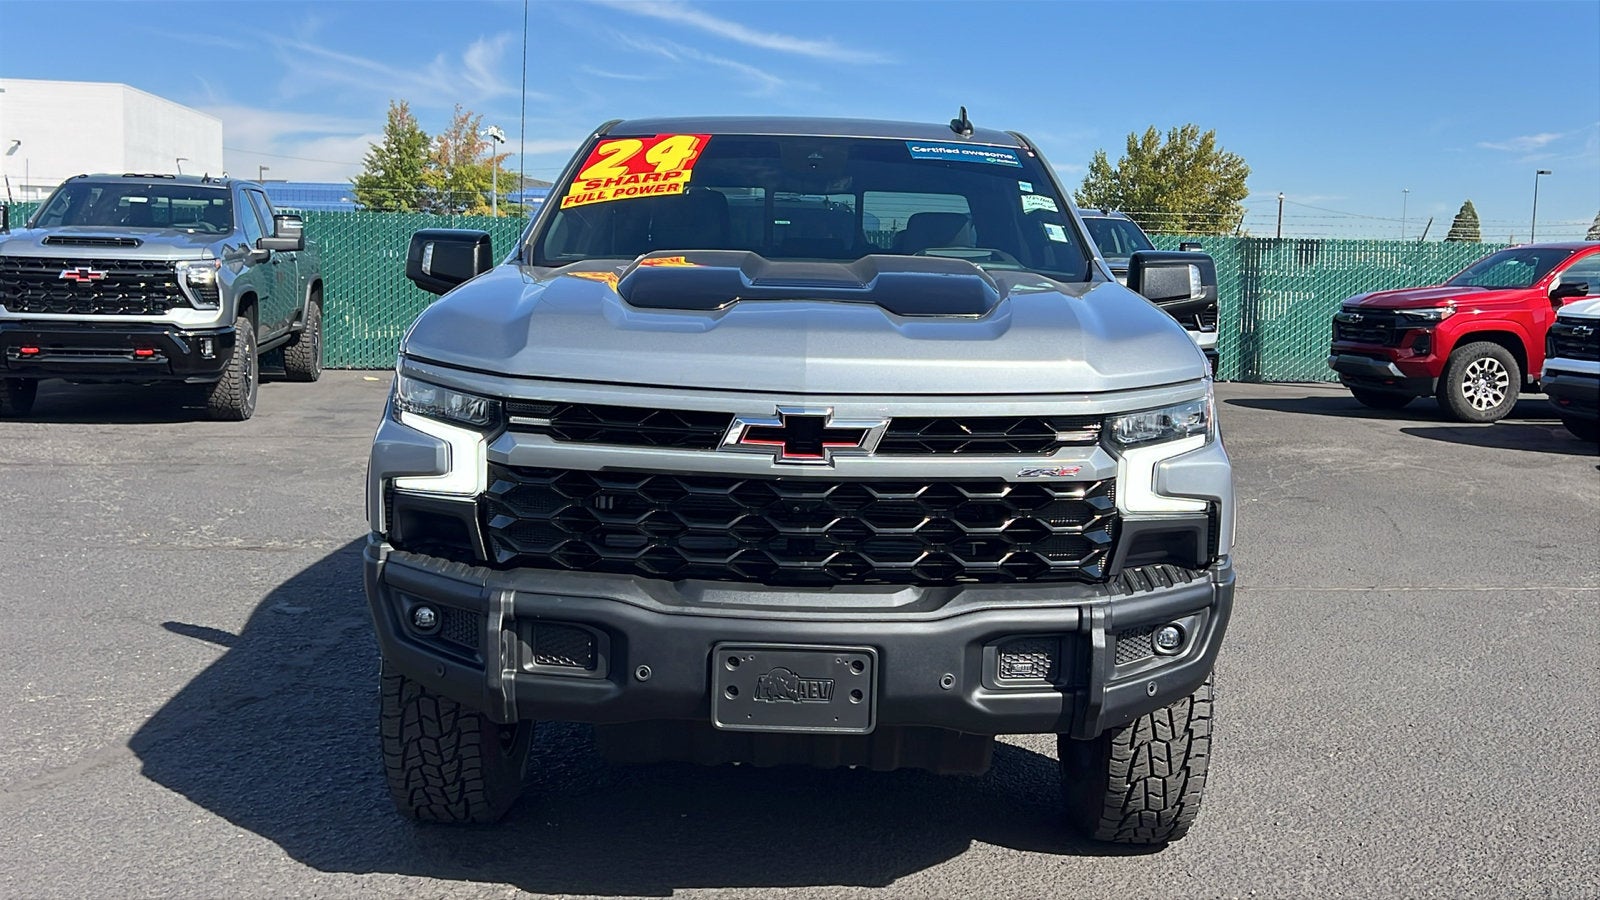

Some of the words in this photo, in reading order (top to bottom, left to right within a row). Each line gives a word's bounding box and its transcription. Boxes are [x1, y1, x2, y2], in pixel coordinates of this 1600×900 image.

[580, 135, 700, 180] 24
[911, 146, 960, 154] Certified
[583, 171, 684, 191] SHARP
[563, 190, 607, 206] FULL
[612, 183, 680, 198] POWER
